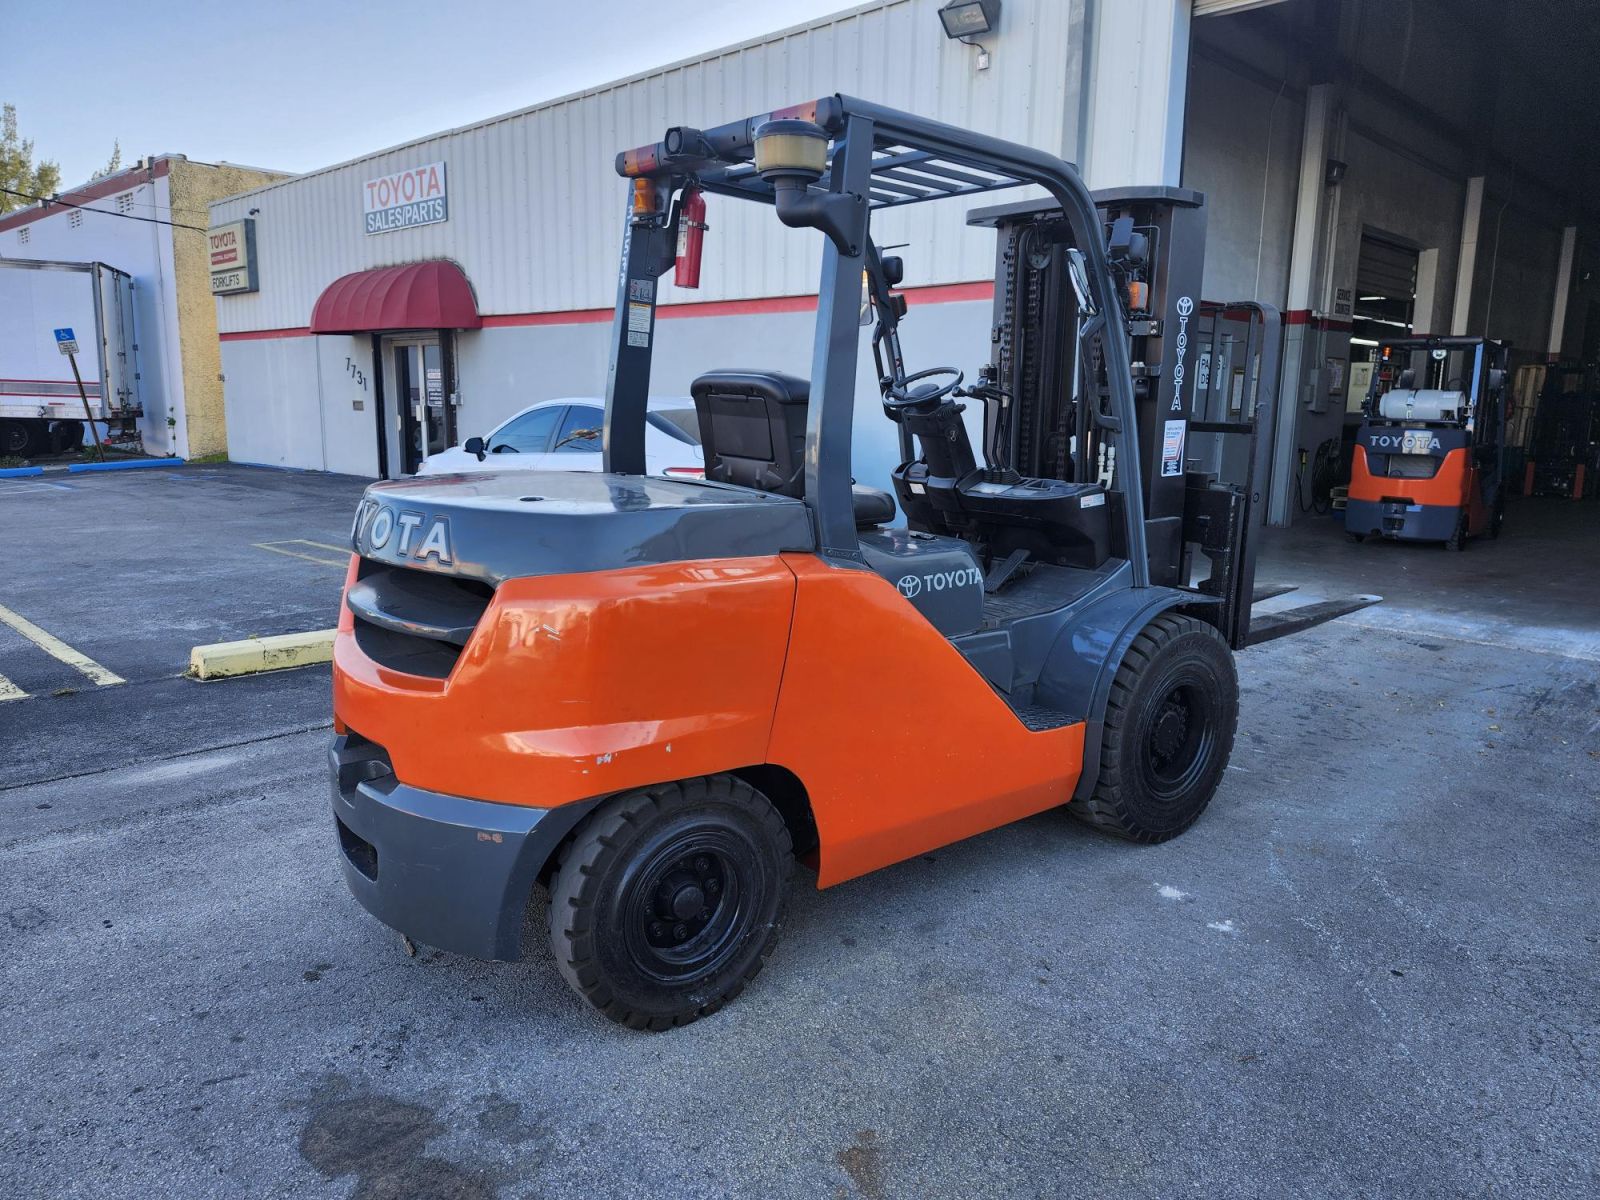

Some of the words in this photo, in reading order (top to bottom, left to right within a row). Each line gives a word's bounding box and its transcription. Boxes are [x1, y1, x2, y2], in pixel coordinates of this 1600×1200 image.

[366, 167, 441, 209] TOYOTA
[367, 198, 443, 231] SALES/PARTS
[209, 231, 236, 249] TOYOTA
[212, 273, 240, 288] FORKLIFTS
[344, 357, 366, 391] 7731
[1170, 317, 1188, 410] TOYOTA
[1370, 435, 1441, 450] TOYOTA
[924, 568, 983, 591] TOYOTA
